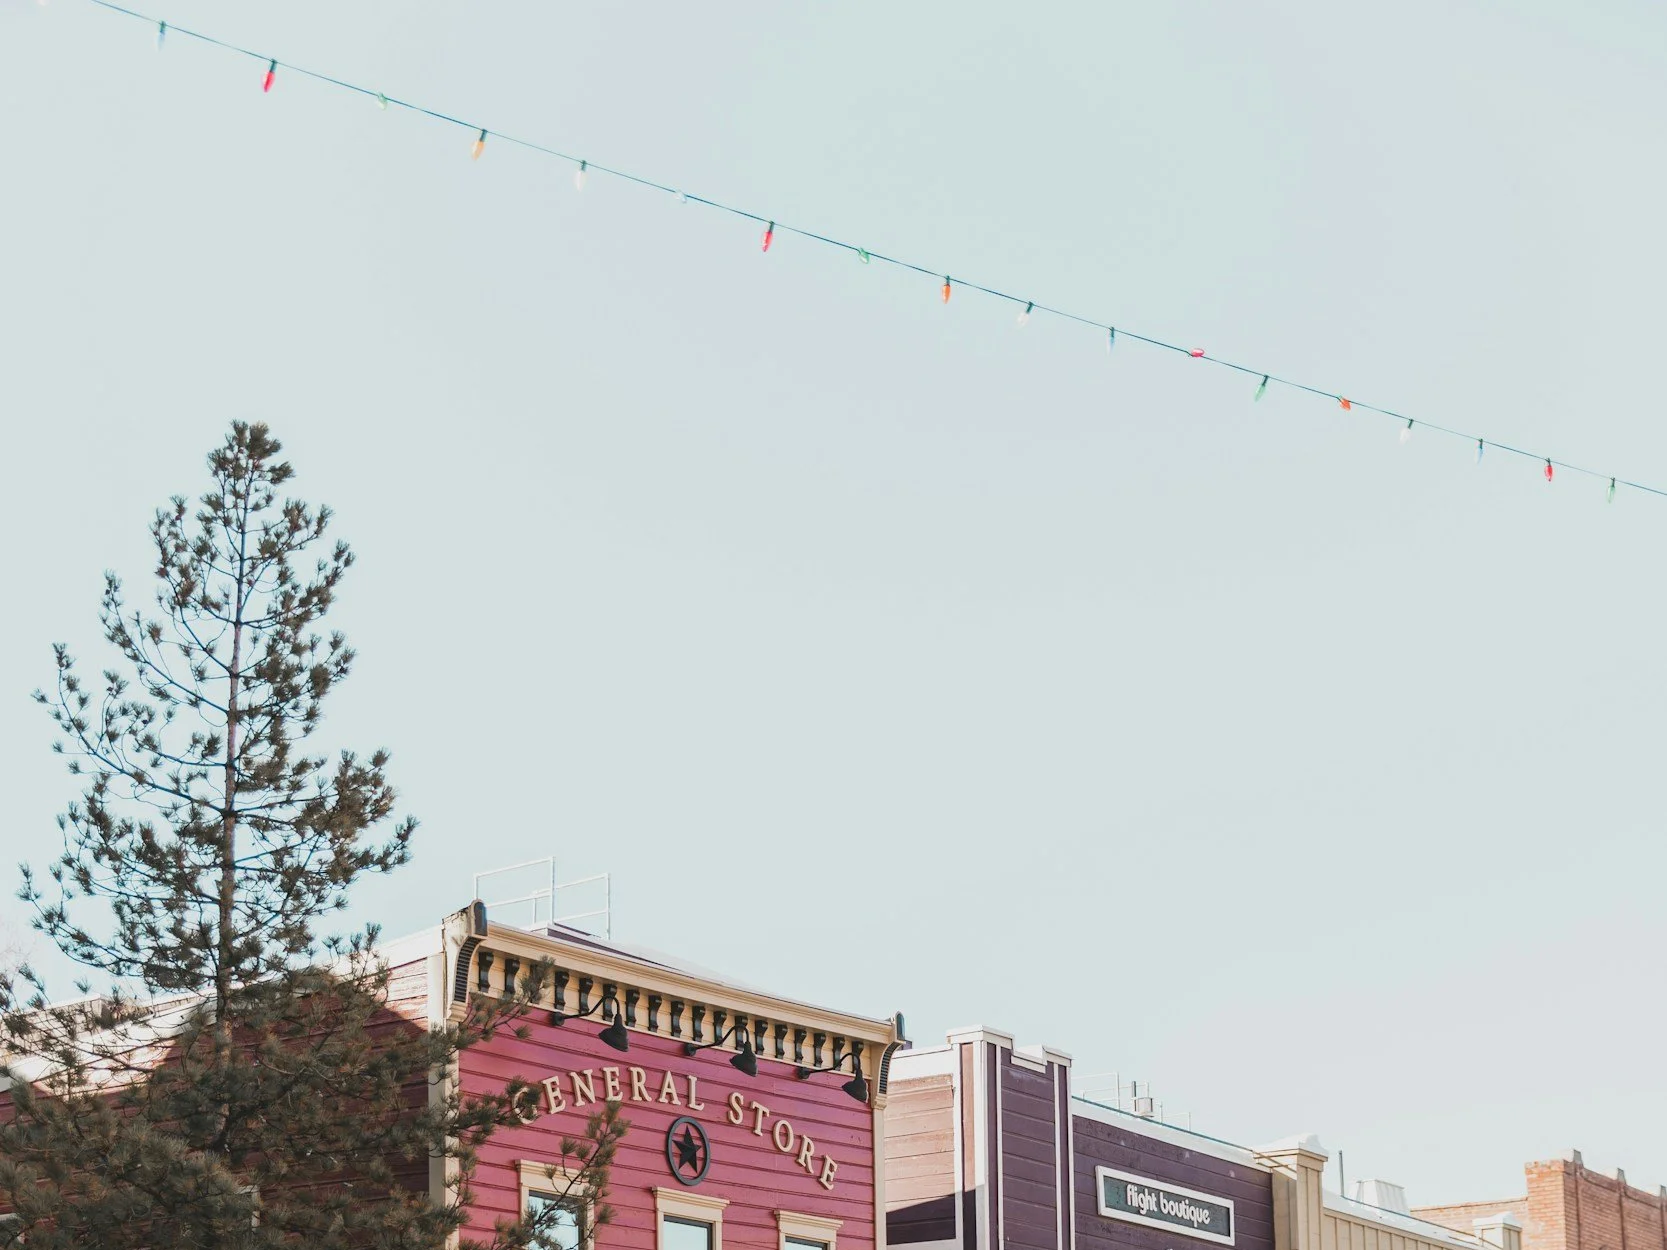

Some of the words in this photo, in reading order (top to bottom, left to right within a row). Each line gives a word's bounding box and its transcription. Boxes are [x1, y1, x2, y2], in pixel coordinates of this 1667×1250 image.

[512, 1066, 705, 1125] GENERAL
[727, 1091, 839, 1191] STORE
[1126, 1184, 1158, 1215] flight
[1160, 1191, 1211, 1228] boutique
